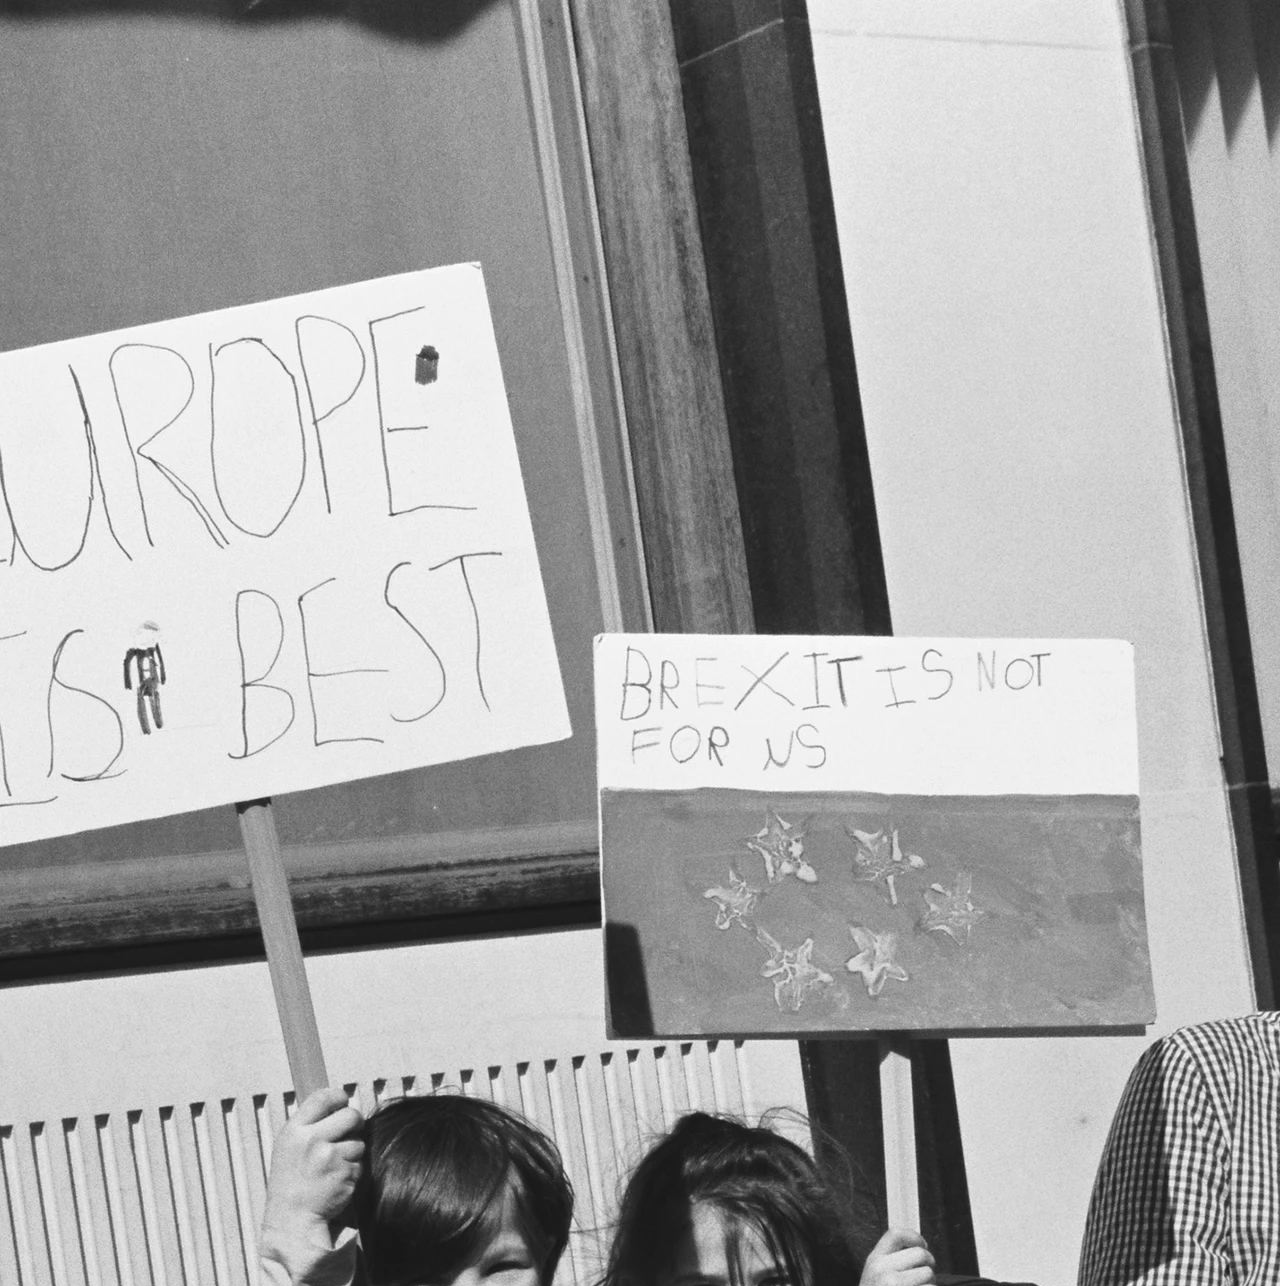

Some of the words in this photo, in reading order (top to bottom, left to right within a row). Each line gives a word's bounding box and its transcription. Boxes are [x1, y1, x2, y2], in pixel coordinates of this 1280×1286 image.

[228, 551, 503, 760] BEST
[620, 646, 863, 721] BREXIT
[875, 649, 954, 709] IS
[977, 650, 1051, 691] NOT
[631, 725, 730, 766] FOR
